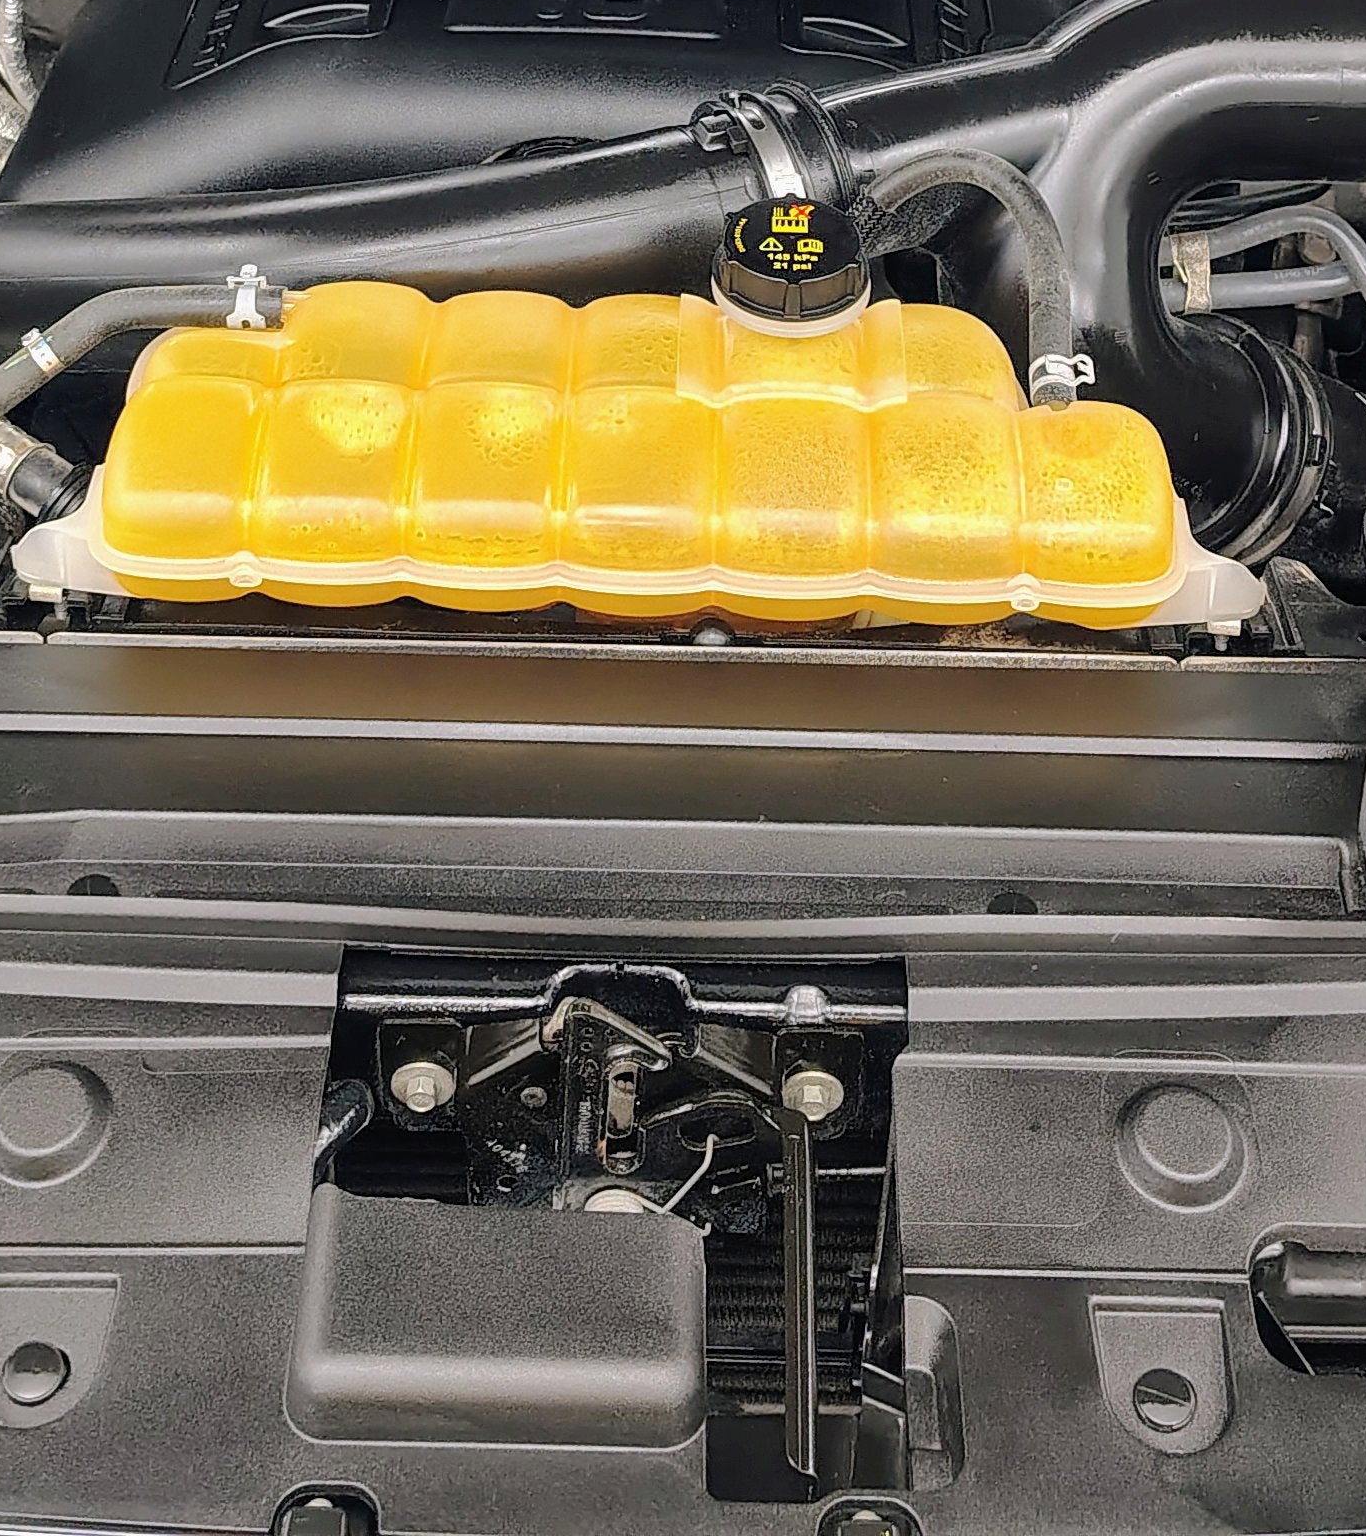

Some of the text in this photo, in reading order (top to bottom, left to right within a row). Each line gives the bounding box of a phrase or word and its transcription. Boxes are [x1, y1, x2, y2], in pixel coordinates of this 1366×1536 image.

[766, 253, 819, 262] 145 kPa
[773, 262, 812, 271] 21 psi
